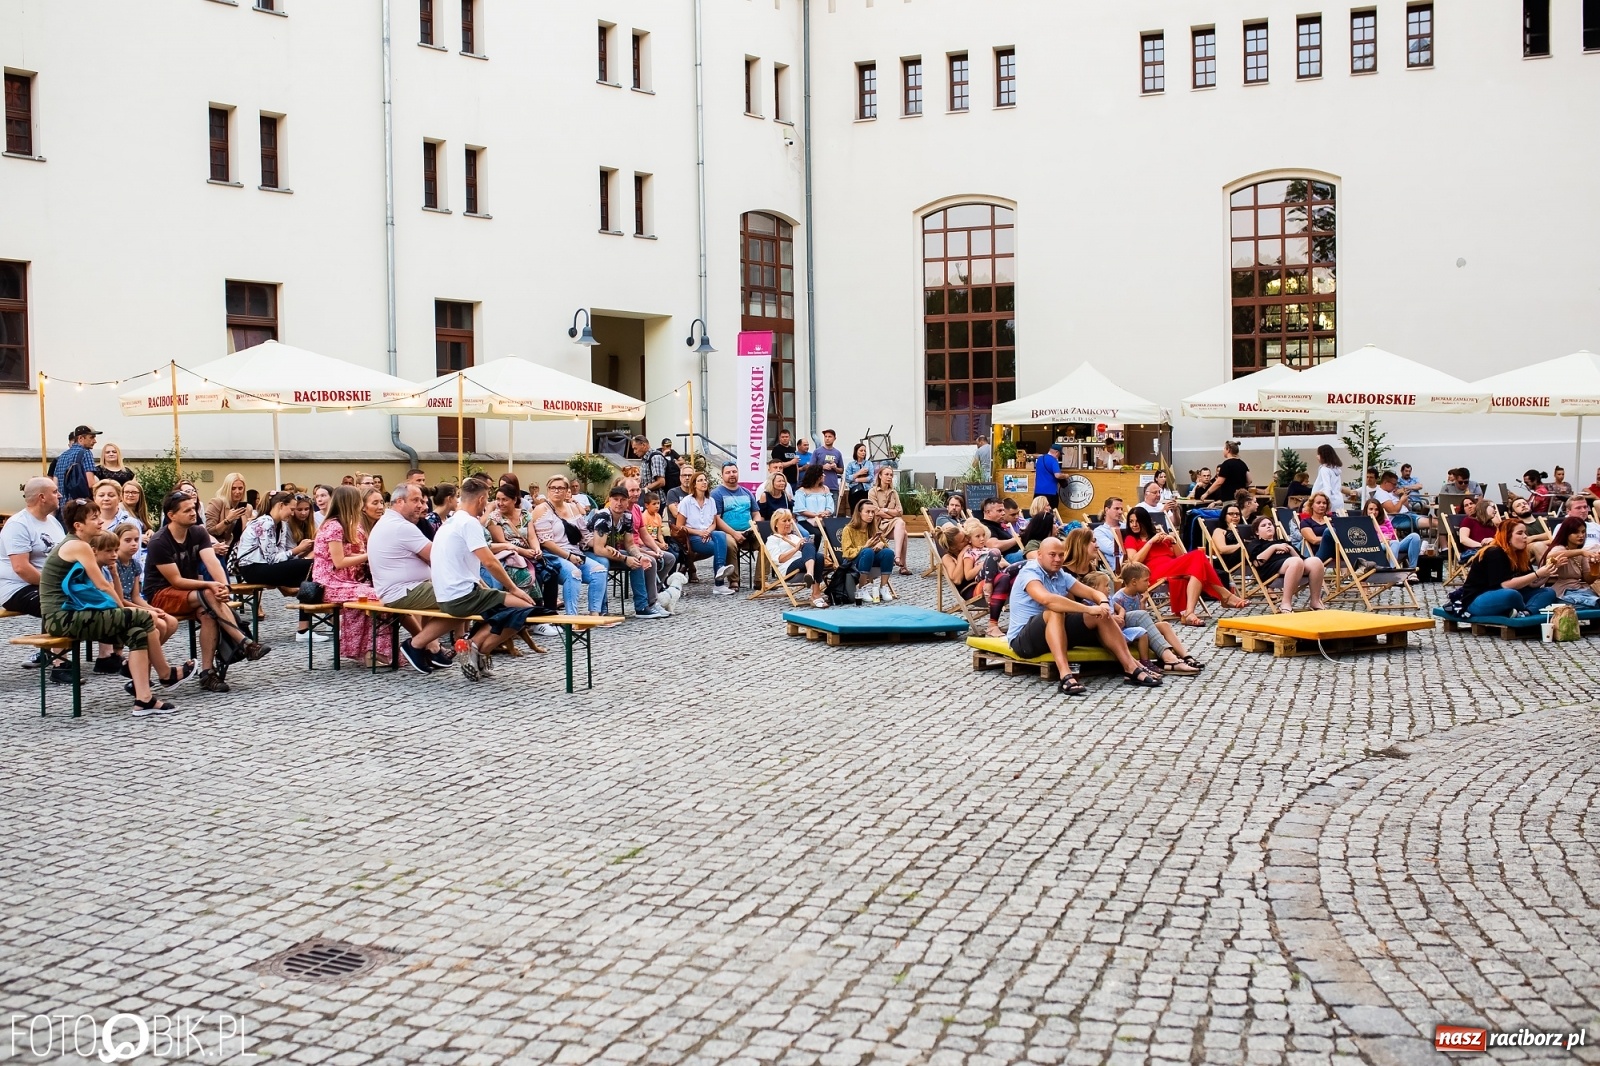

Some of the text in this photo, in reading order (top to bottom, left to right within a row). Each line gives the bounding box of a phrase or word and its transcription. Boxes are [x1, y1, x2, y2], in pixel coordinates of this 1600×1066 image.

[148, 394, 189, 408] RACIBORKIE
[294, 390, 372, 402] RACIBORSKIE
[1327, 393, 1417, 406] RACIBORSKIE
[1491, 396, 1550, 407] ACIBORSKIE
[427, 397, 453, 408] ORSKIE
[543, 399, 603, 413] RACIBORSKIE
[1031, 407, 1119, 419] BROWAR ZAMKOWY
